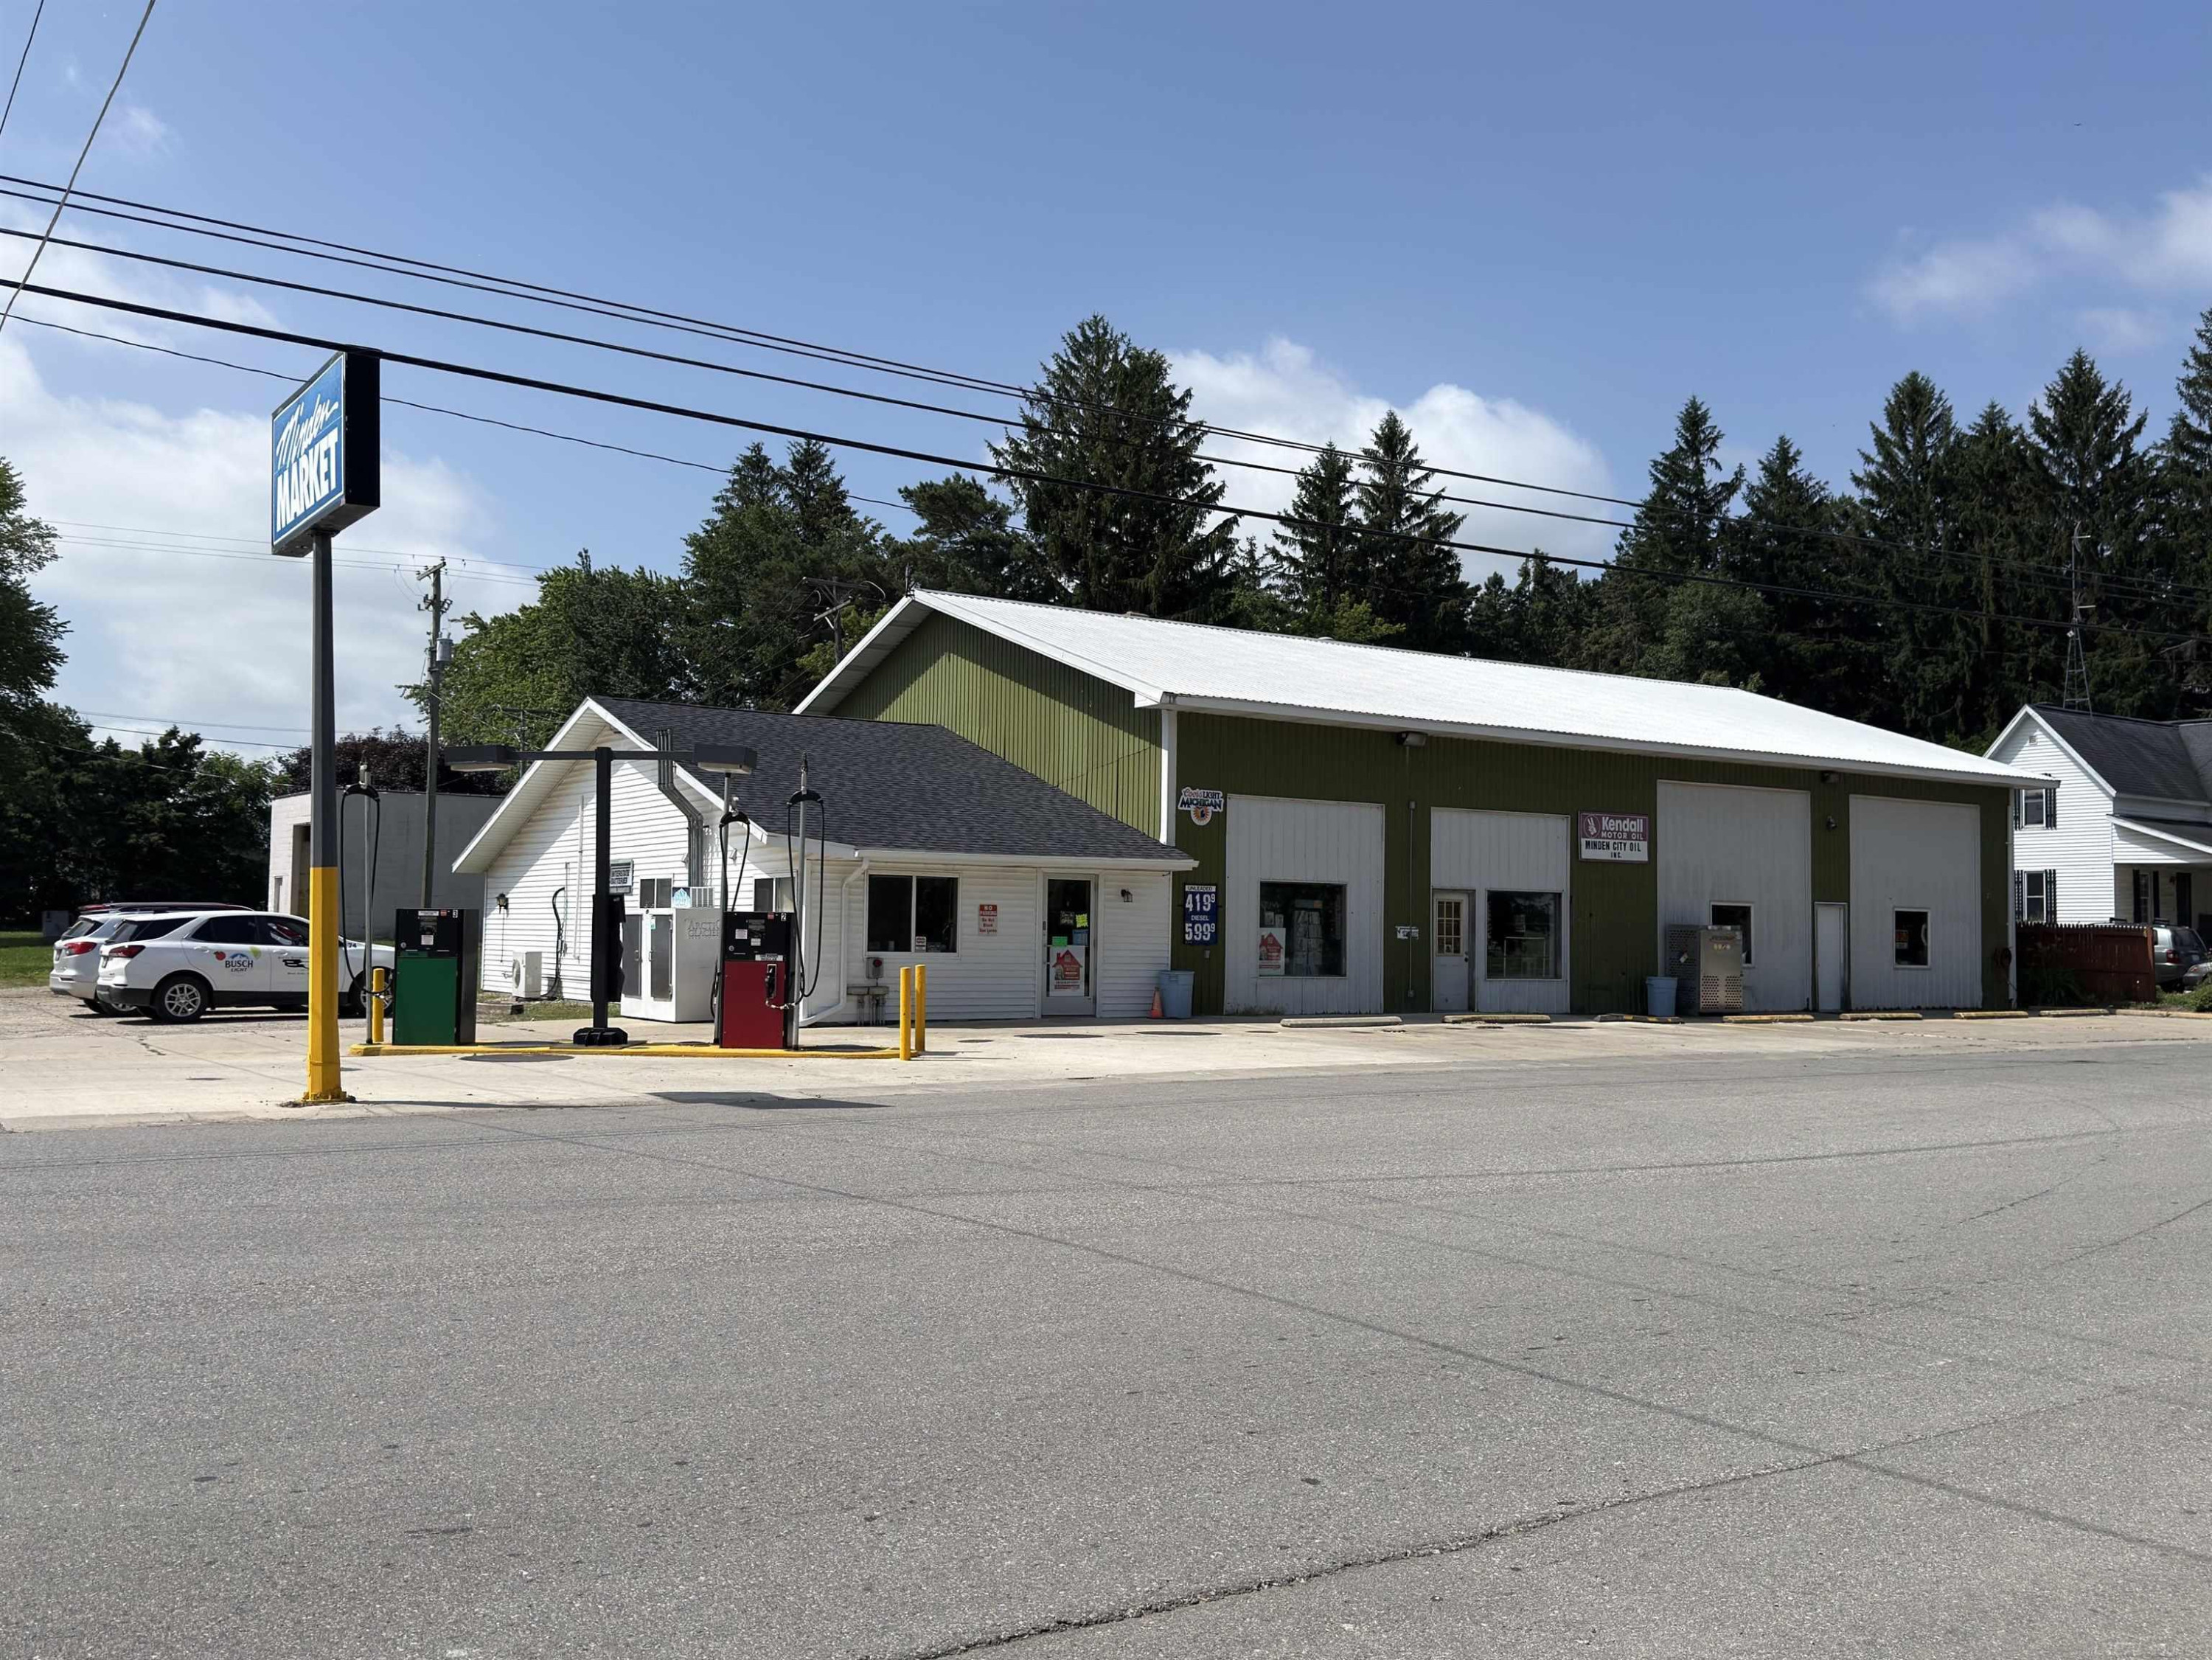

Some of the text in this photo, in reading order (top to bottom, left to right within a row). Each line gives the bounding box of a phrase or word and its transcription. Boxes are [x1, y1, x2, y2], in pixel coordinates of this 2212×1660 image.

[276, 393, 338, 468] Minden
[276, 426, 338, 532] MARKET
[1183, 788, 1221, 799] Coors LIGHT
[1180, 798, 1222, 810] MICHIGAN
[1601, 816, 1644, 833] Kendall
[1601, 831, 1628, 839] MOTOR
[1585, 840, 1641, 852] MINDEN CITY OIL
[453, 910, 458, 918] 3
[781, 913, 786, 921] 2
[225, 959, 254, 968] BUSCH
